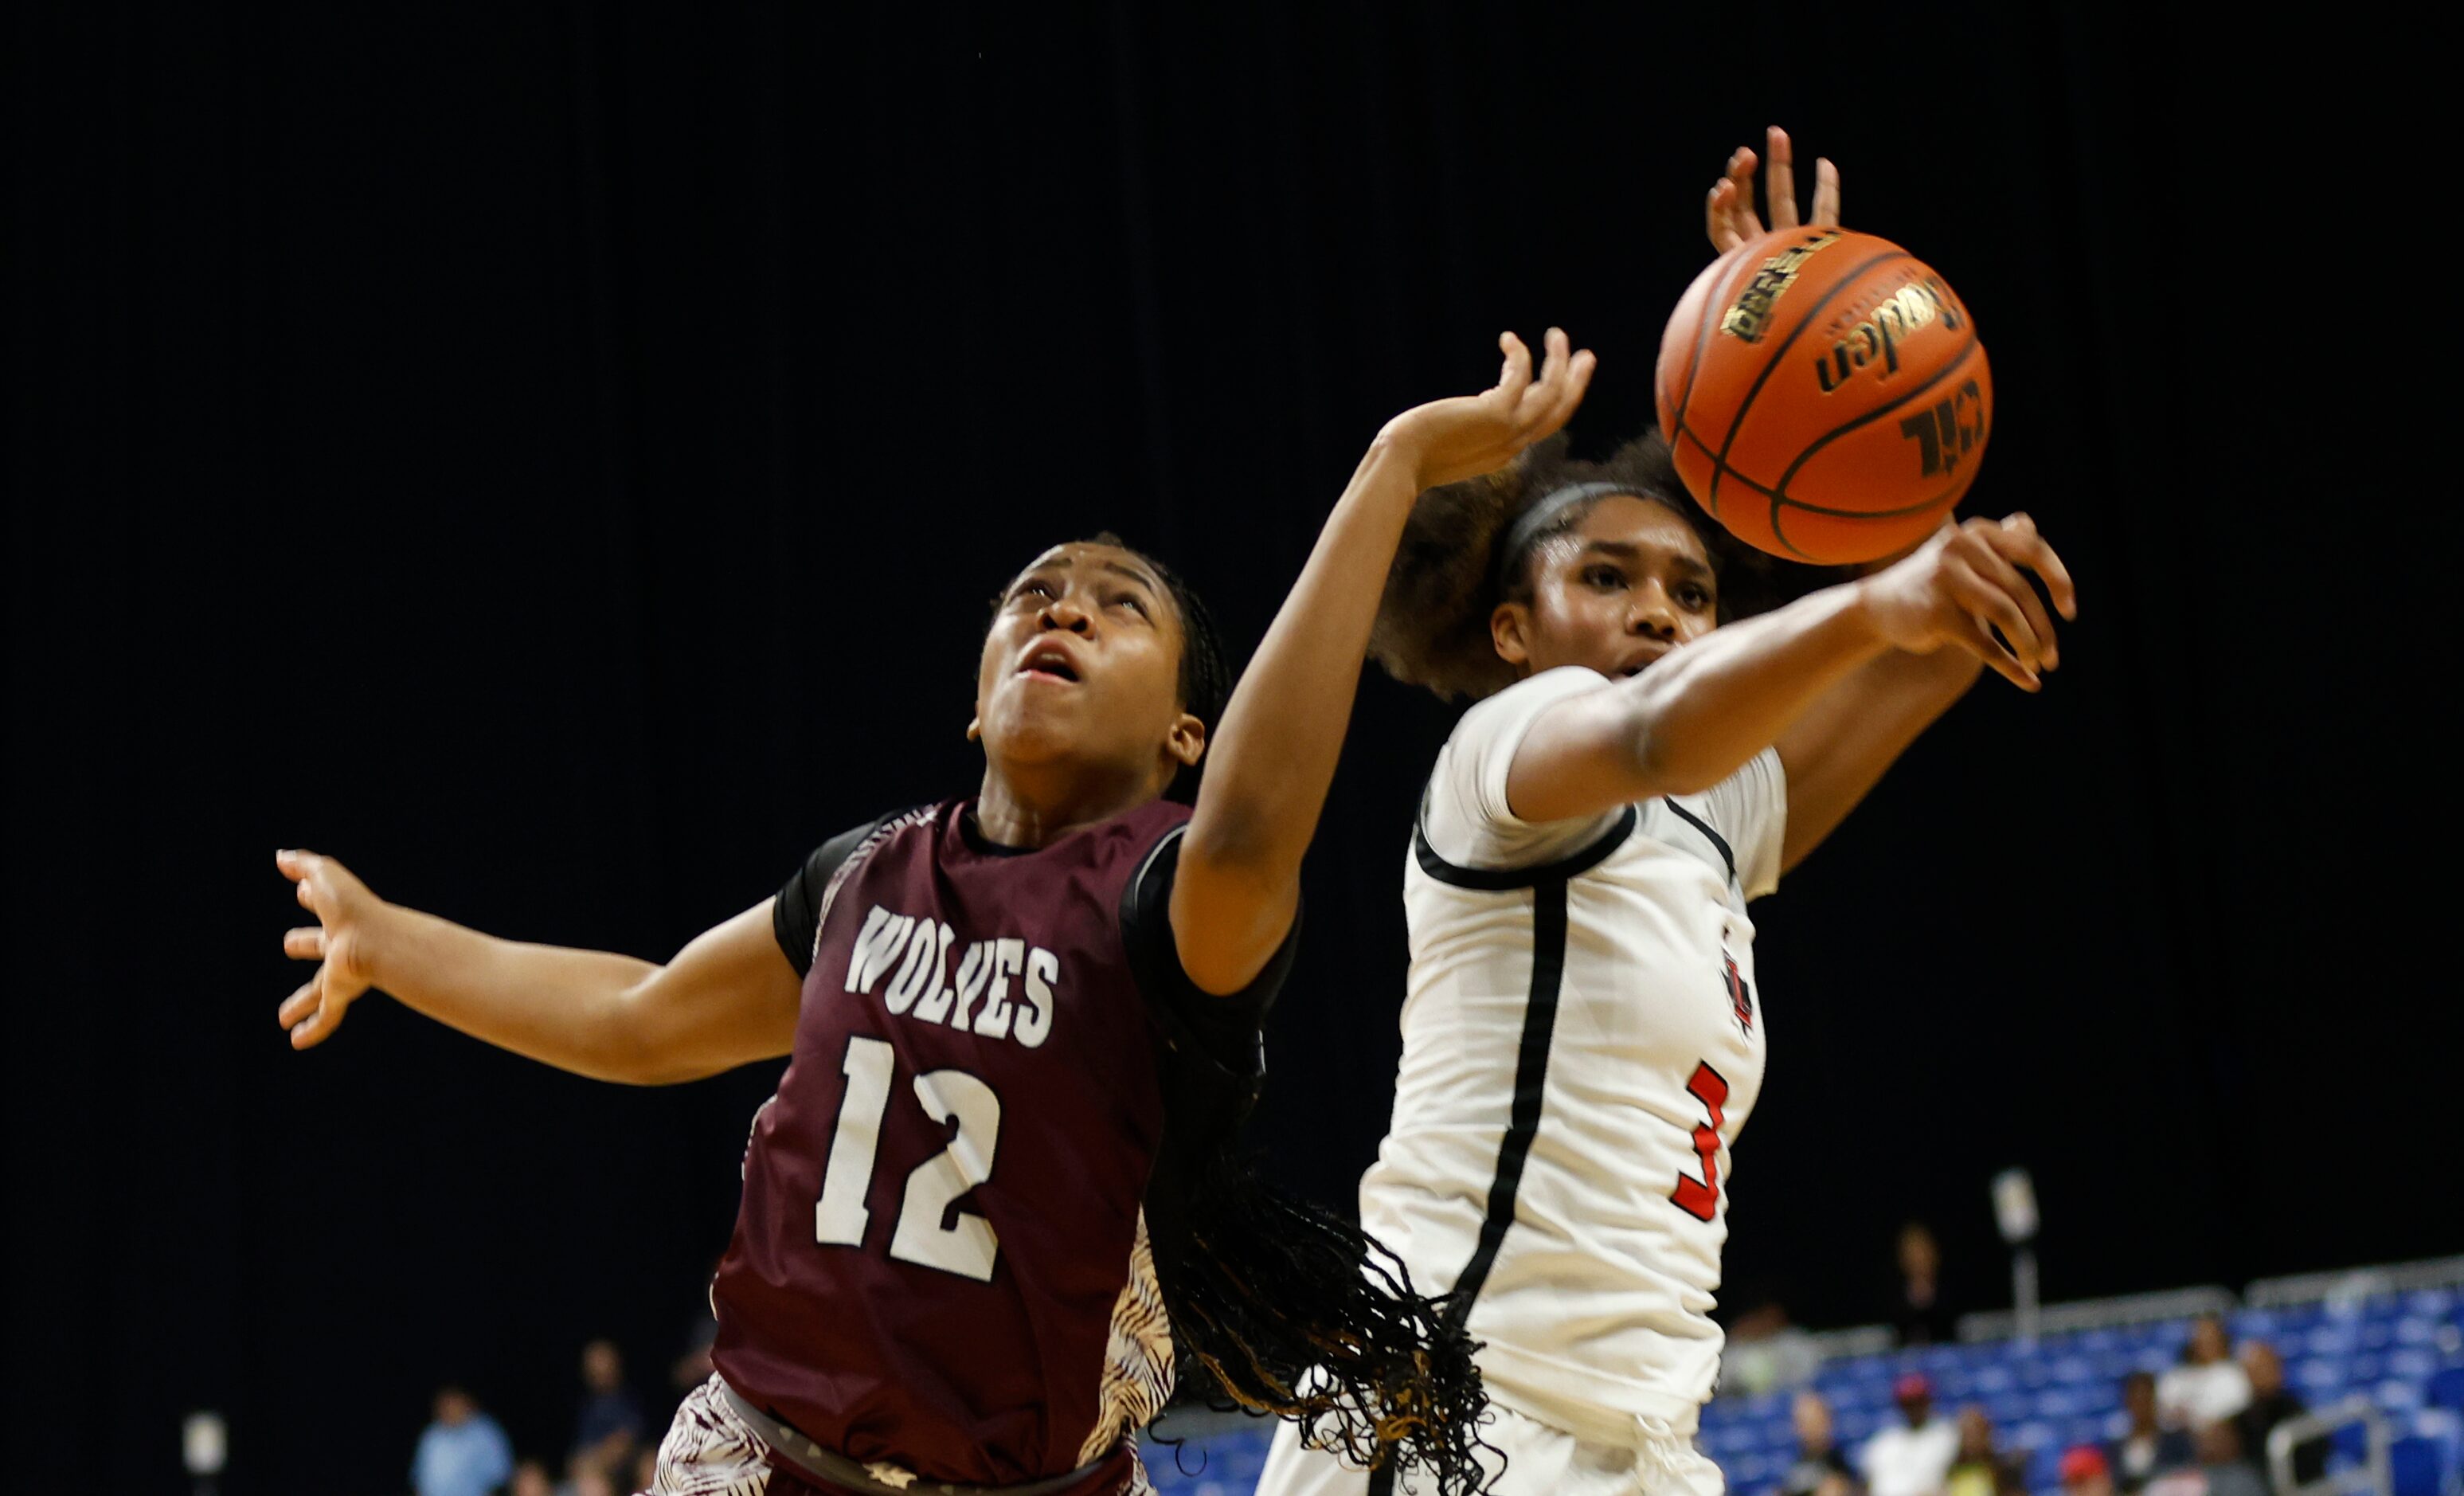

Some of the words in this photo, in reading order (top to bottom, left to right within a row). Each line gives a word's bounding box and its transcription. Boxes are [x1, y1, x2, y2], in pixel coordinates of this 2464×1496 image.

[844, 904, 1059, 1048] WOLVES
[815, 1036, 1001, 1283] 12
[1669, 1059, 1729, 1223] 3
